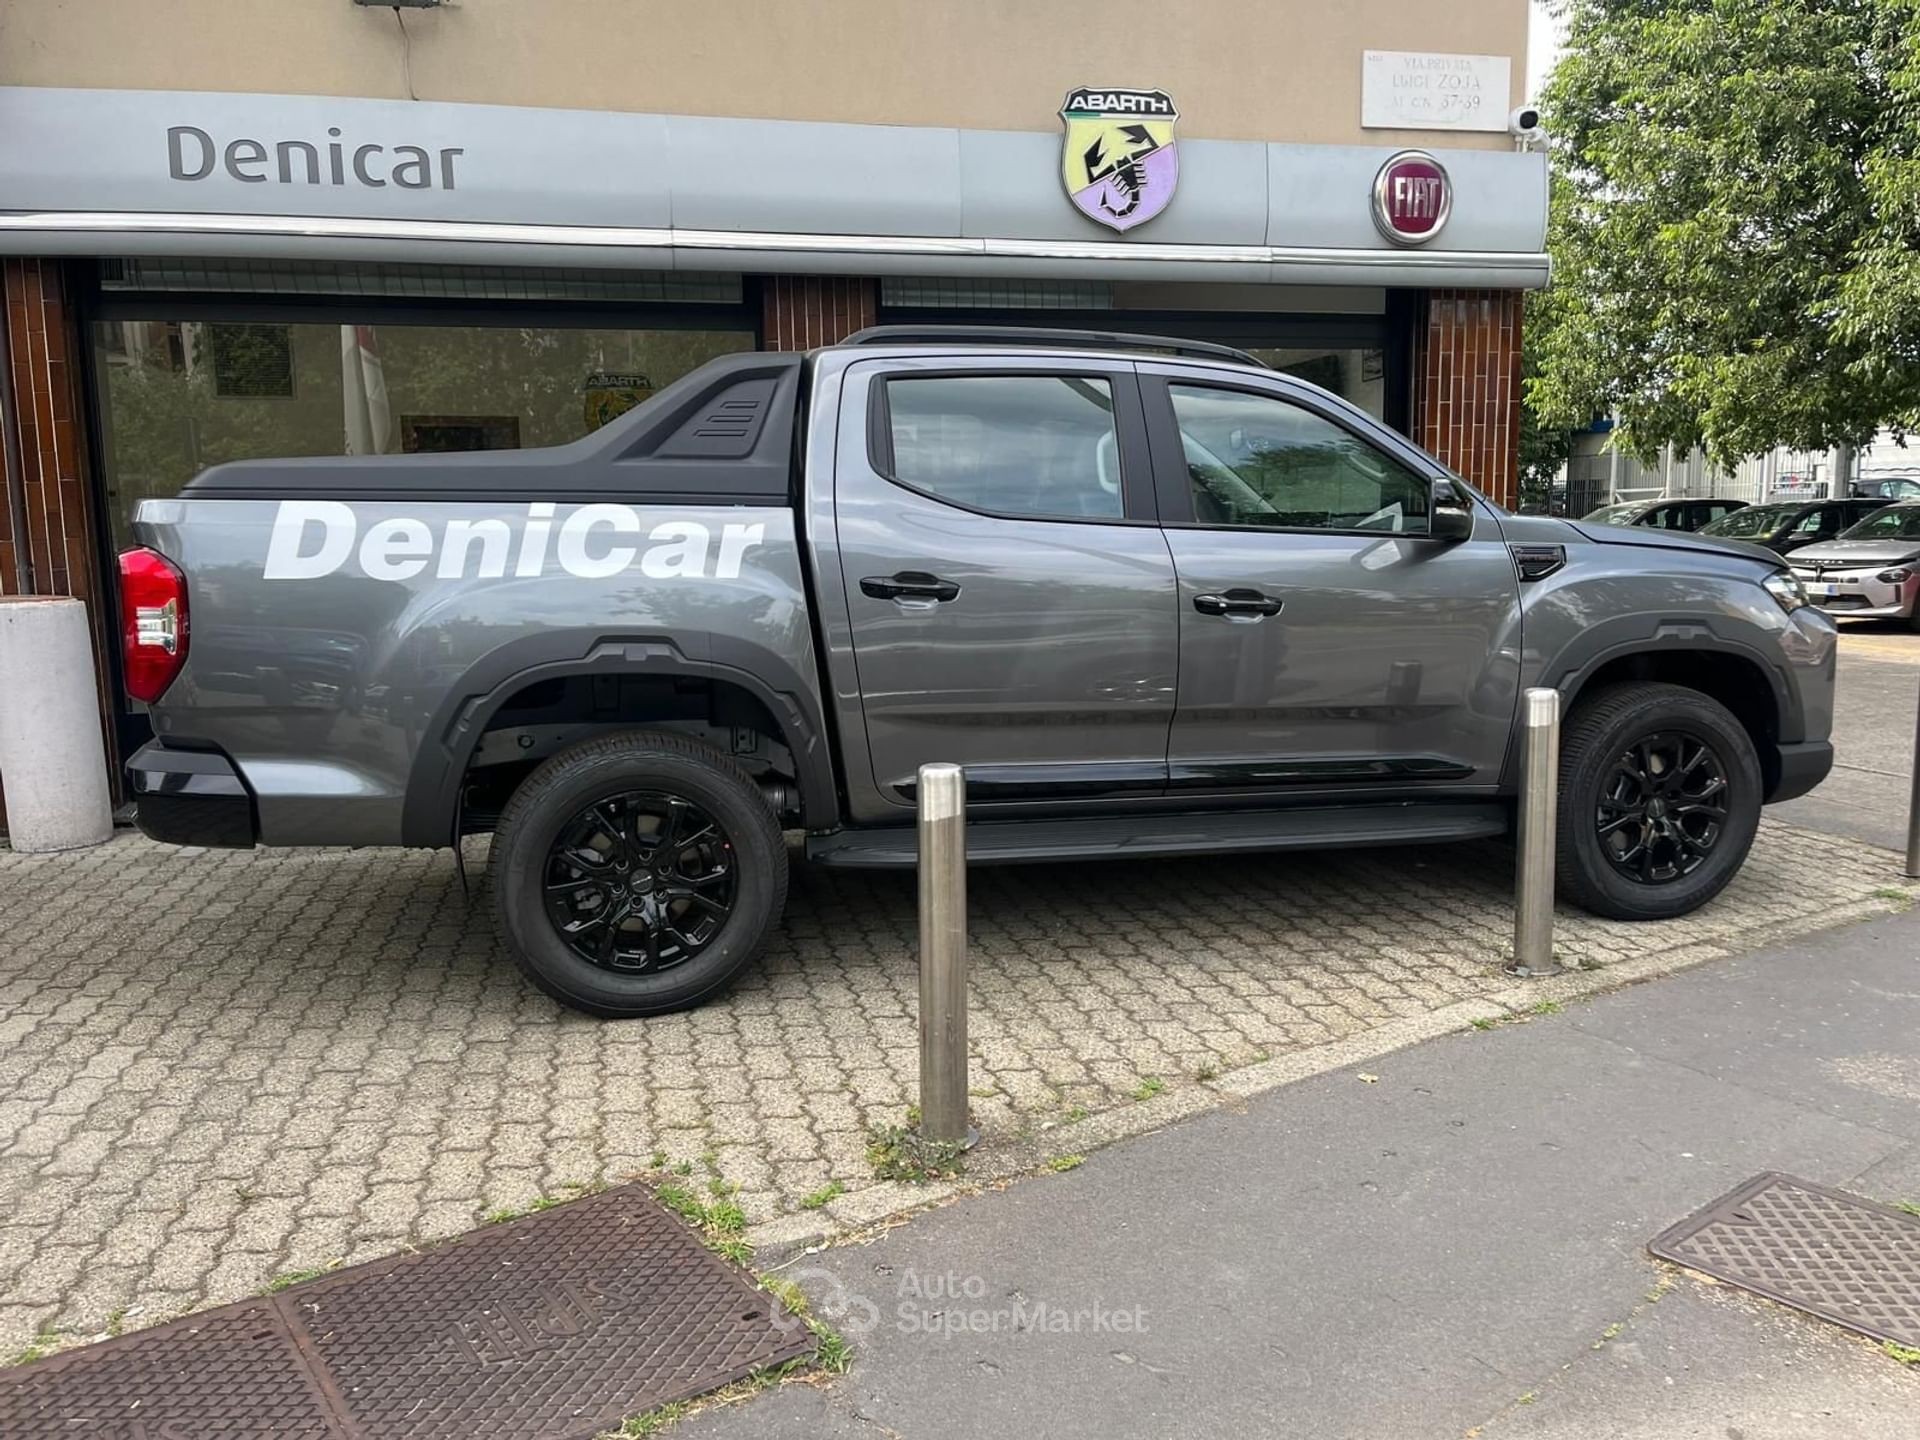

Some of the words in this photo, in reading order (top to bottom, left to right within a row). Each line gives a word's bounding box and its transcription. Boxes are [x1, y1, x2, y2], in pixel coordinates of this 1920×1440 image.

[1437, 74, 1480, 90] ZOJA
[1070, 94, 1168, 112] ABARTH
[167, 126, 464, 190] Denicar
[1394, 177, 1440, 218] FIAT
[263, 500, 765, 582] DeniCar
